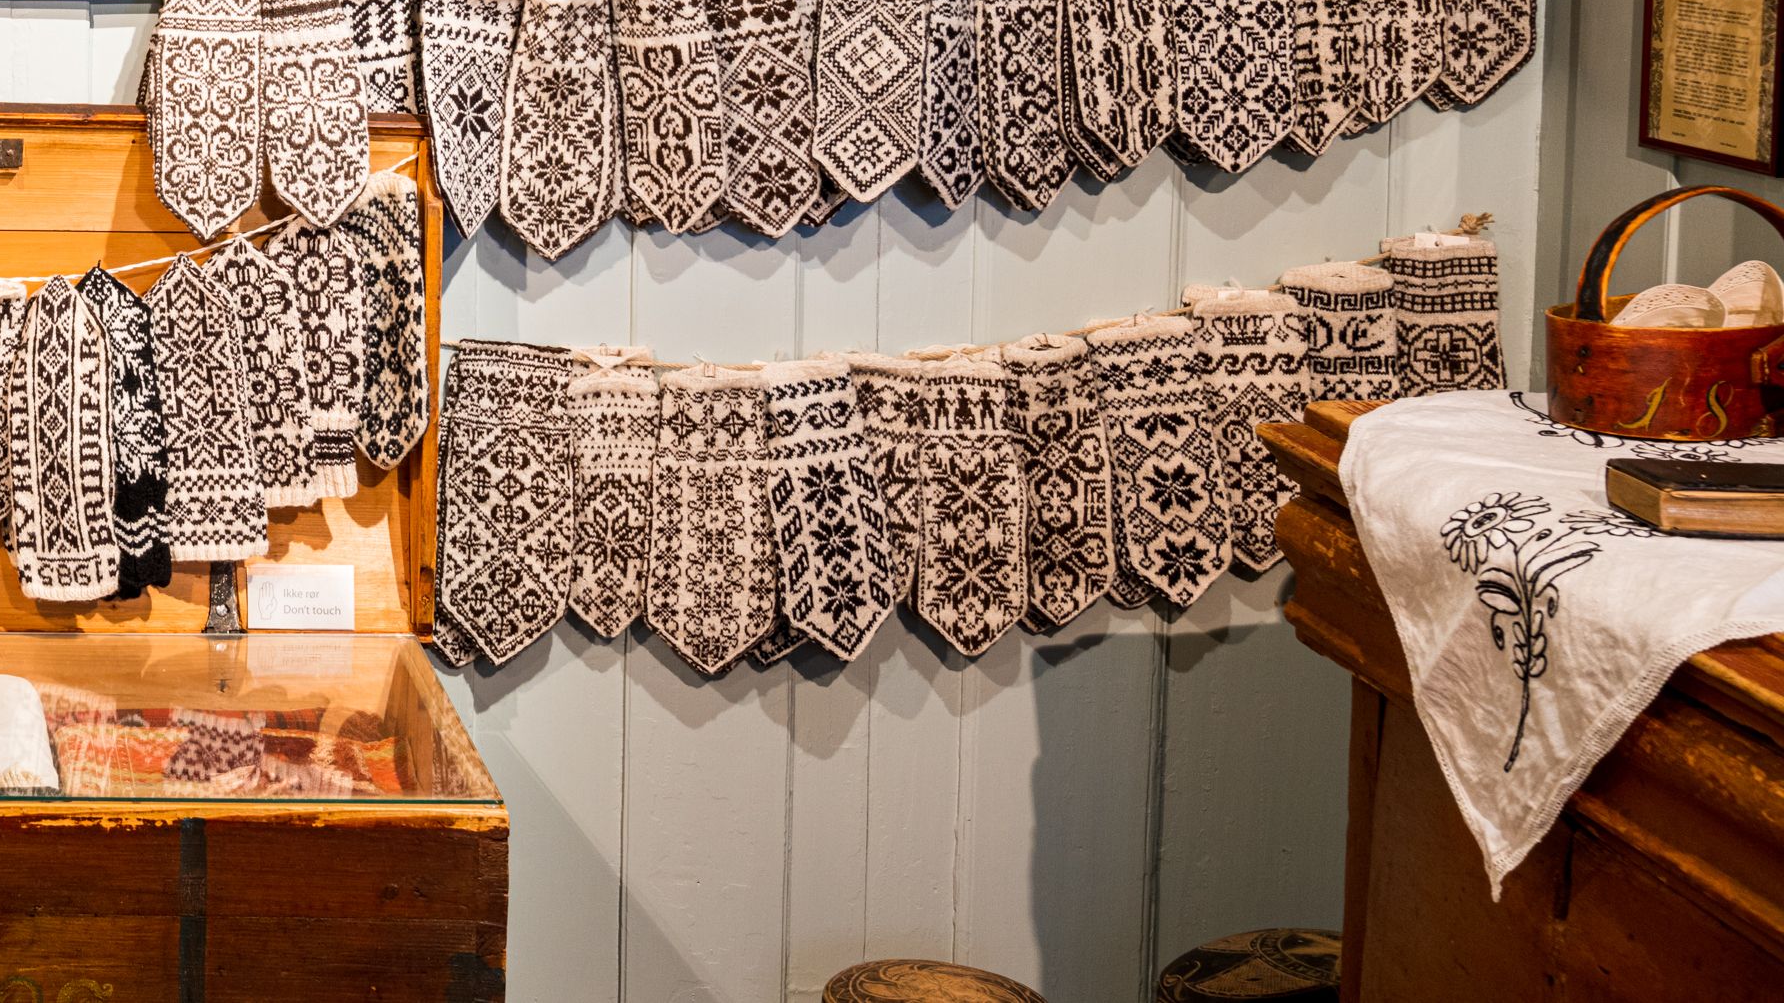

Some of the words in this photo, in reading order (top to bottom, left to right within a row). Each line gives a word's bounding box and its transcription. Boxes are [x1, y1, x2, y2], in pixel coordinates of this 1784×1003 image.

[79, 335, 116, 548] BRUDEPAR
[38, 561, 102, 586] 1985
[283, 589, 303, 598] Ikke
[306, 590, 320, 598] rør
[283, 604, 310, 615] Don't
[312, 605, 341, 616] touch
